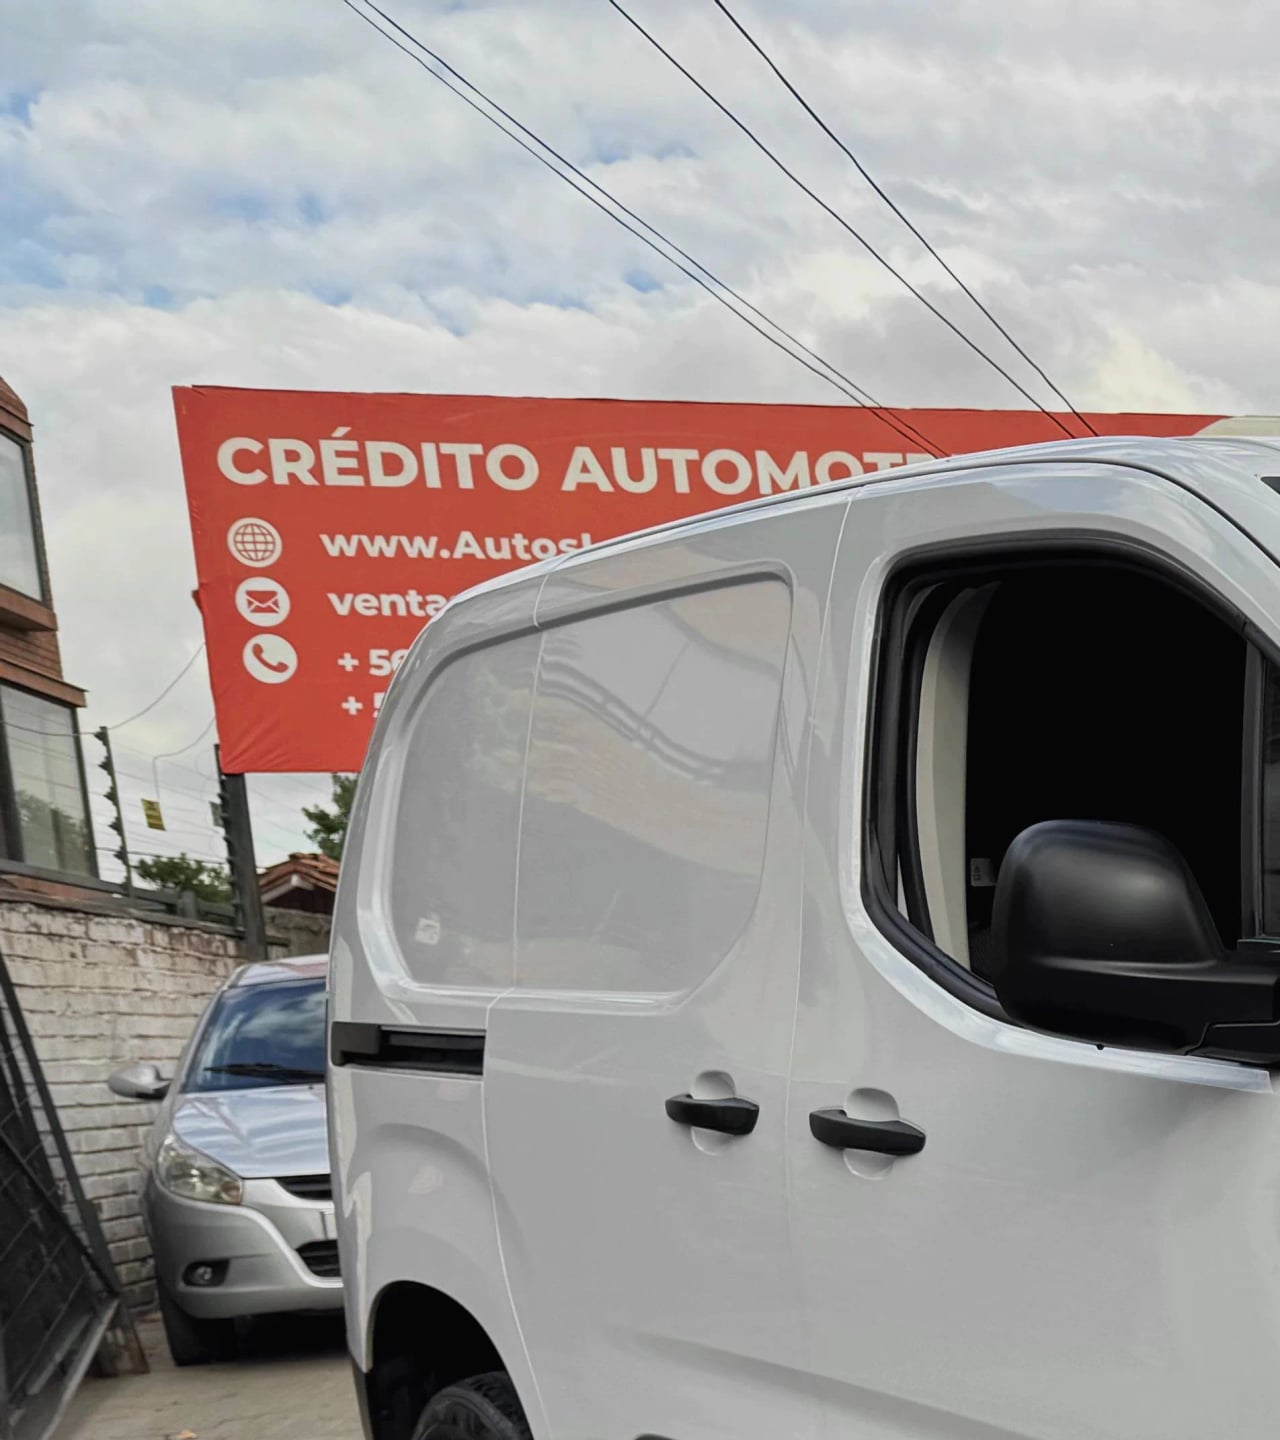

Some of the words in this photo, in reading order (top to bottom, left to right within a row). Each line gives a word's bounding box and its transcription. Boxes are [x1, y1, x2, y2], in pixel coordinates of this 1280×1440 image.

[216, 426, 540, 491] CRÉDITO
[561, 446, 940, 496] AUTOMOT
[326, 589, 453, 617] venta
